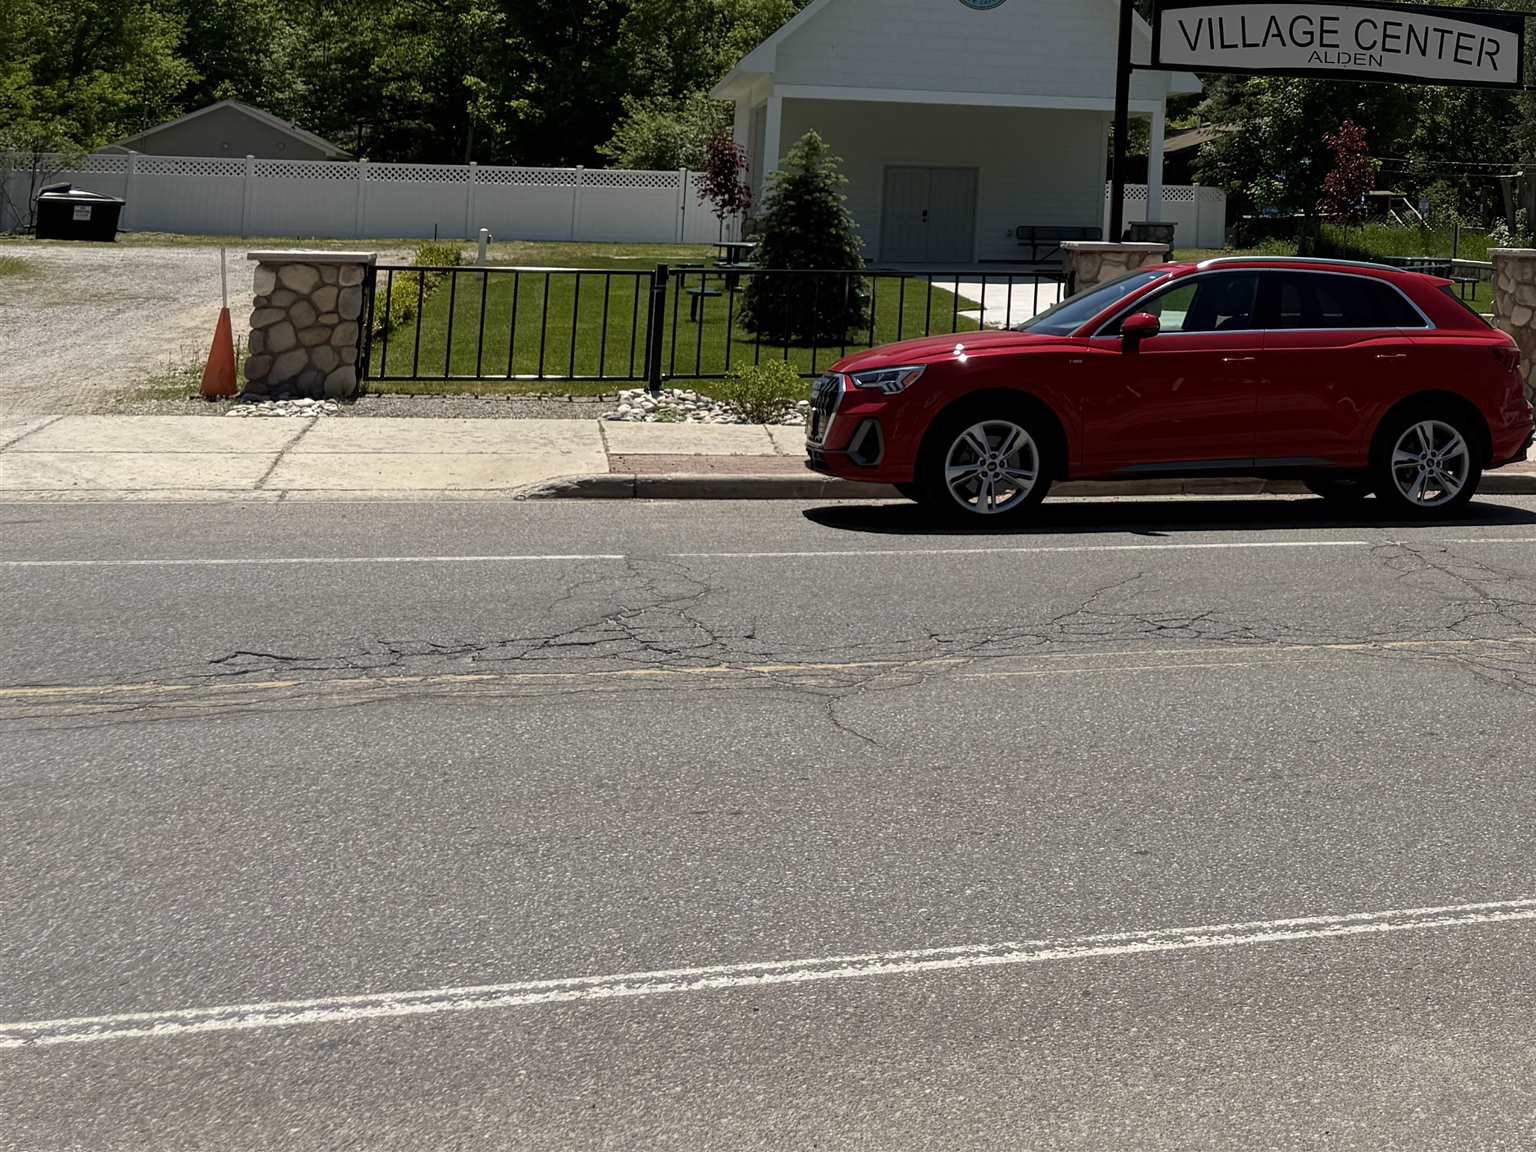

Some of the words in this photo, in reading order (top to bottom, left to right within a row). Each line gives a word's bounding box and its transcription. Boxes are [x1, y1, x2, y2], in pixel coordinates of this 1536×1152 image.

[1178, 15, 1340, 51] VILLAGE
[1354, 18, 1500, 71] CENTER
[1308, 50, 1383, 68] ALDEN
